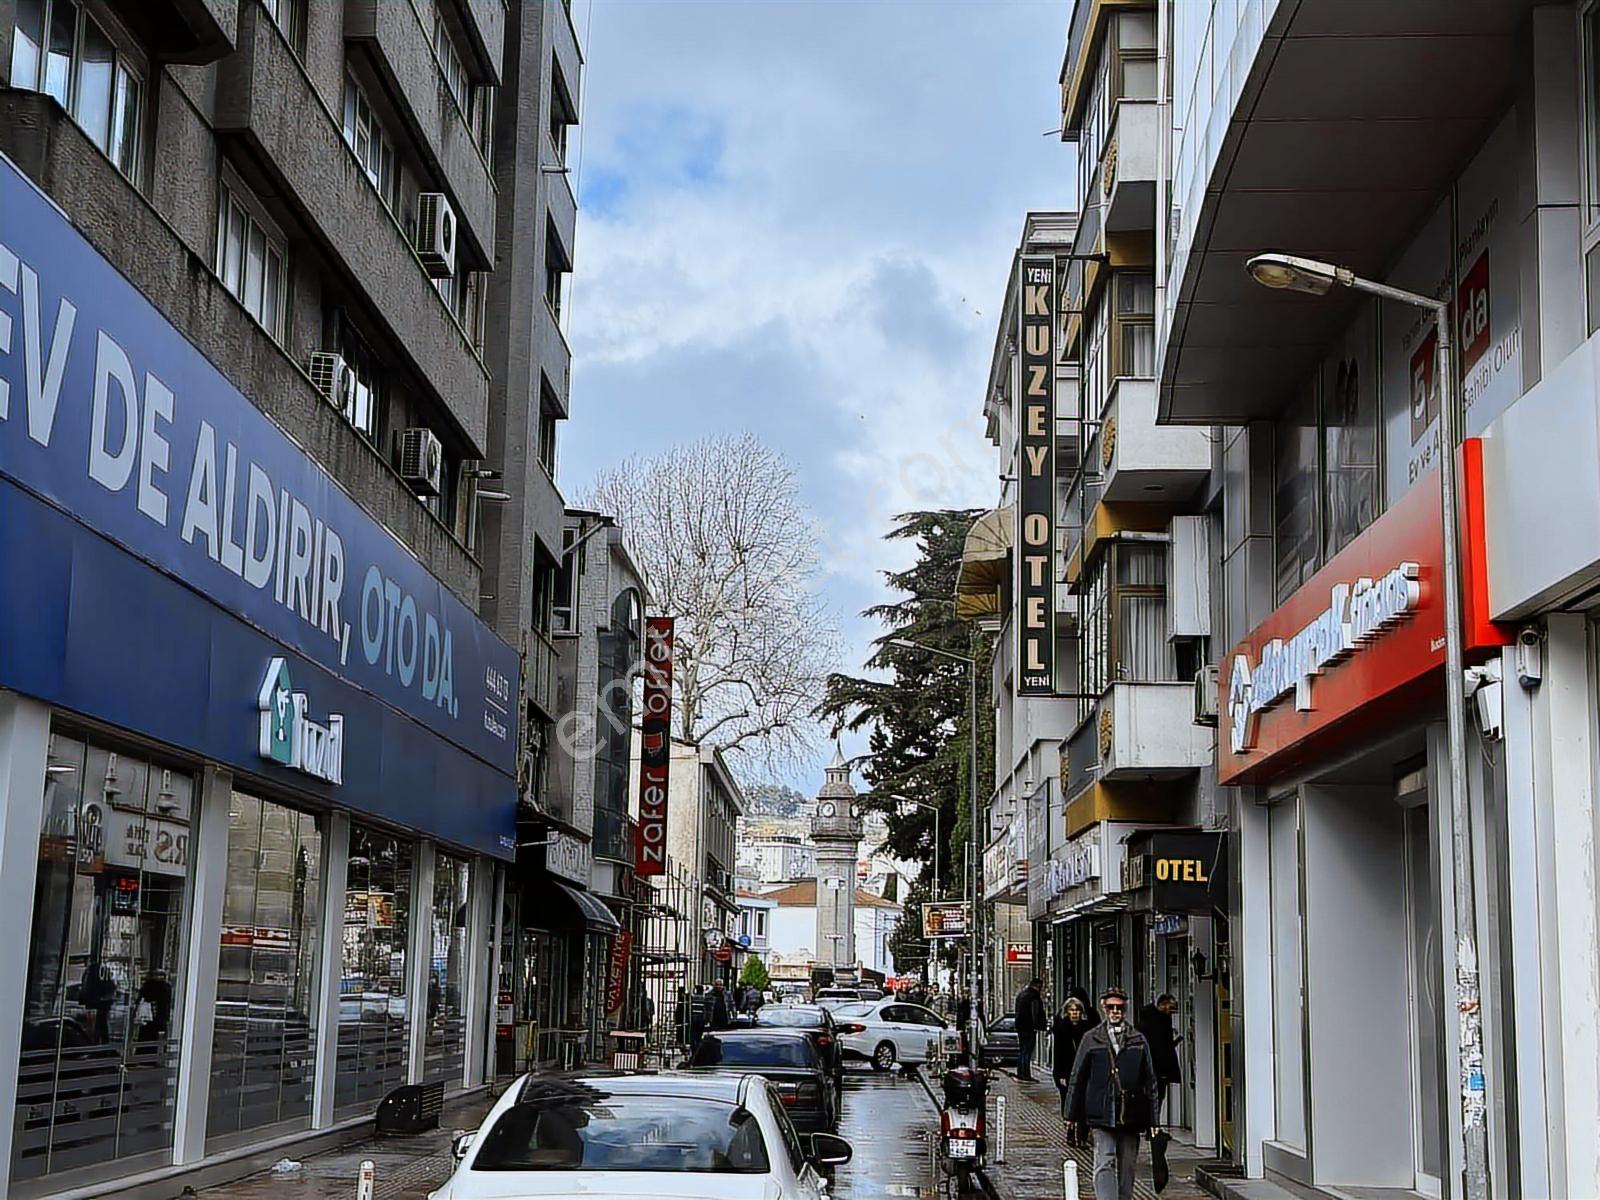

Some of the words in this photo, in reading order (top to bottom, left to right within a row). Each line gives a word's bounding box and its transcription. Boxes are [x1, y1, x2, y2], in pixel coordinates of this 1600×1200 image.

[1024, 285, 1050, 476] KUZEY
[88, 328, 175, 529] DE
[180, 419, 352, 667] ALDIRIR,
[360, 565, 419, 688] OTO
[1024, 513, 1049, 670] OTEL
[646, 627, 670, 713] ofset
[1024, 674, 1050, 687] YENİ
[640, 773, 665, 863] zafer
[1156, 858, 1208, 881] OTEL
